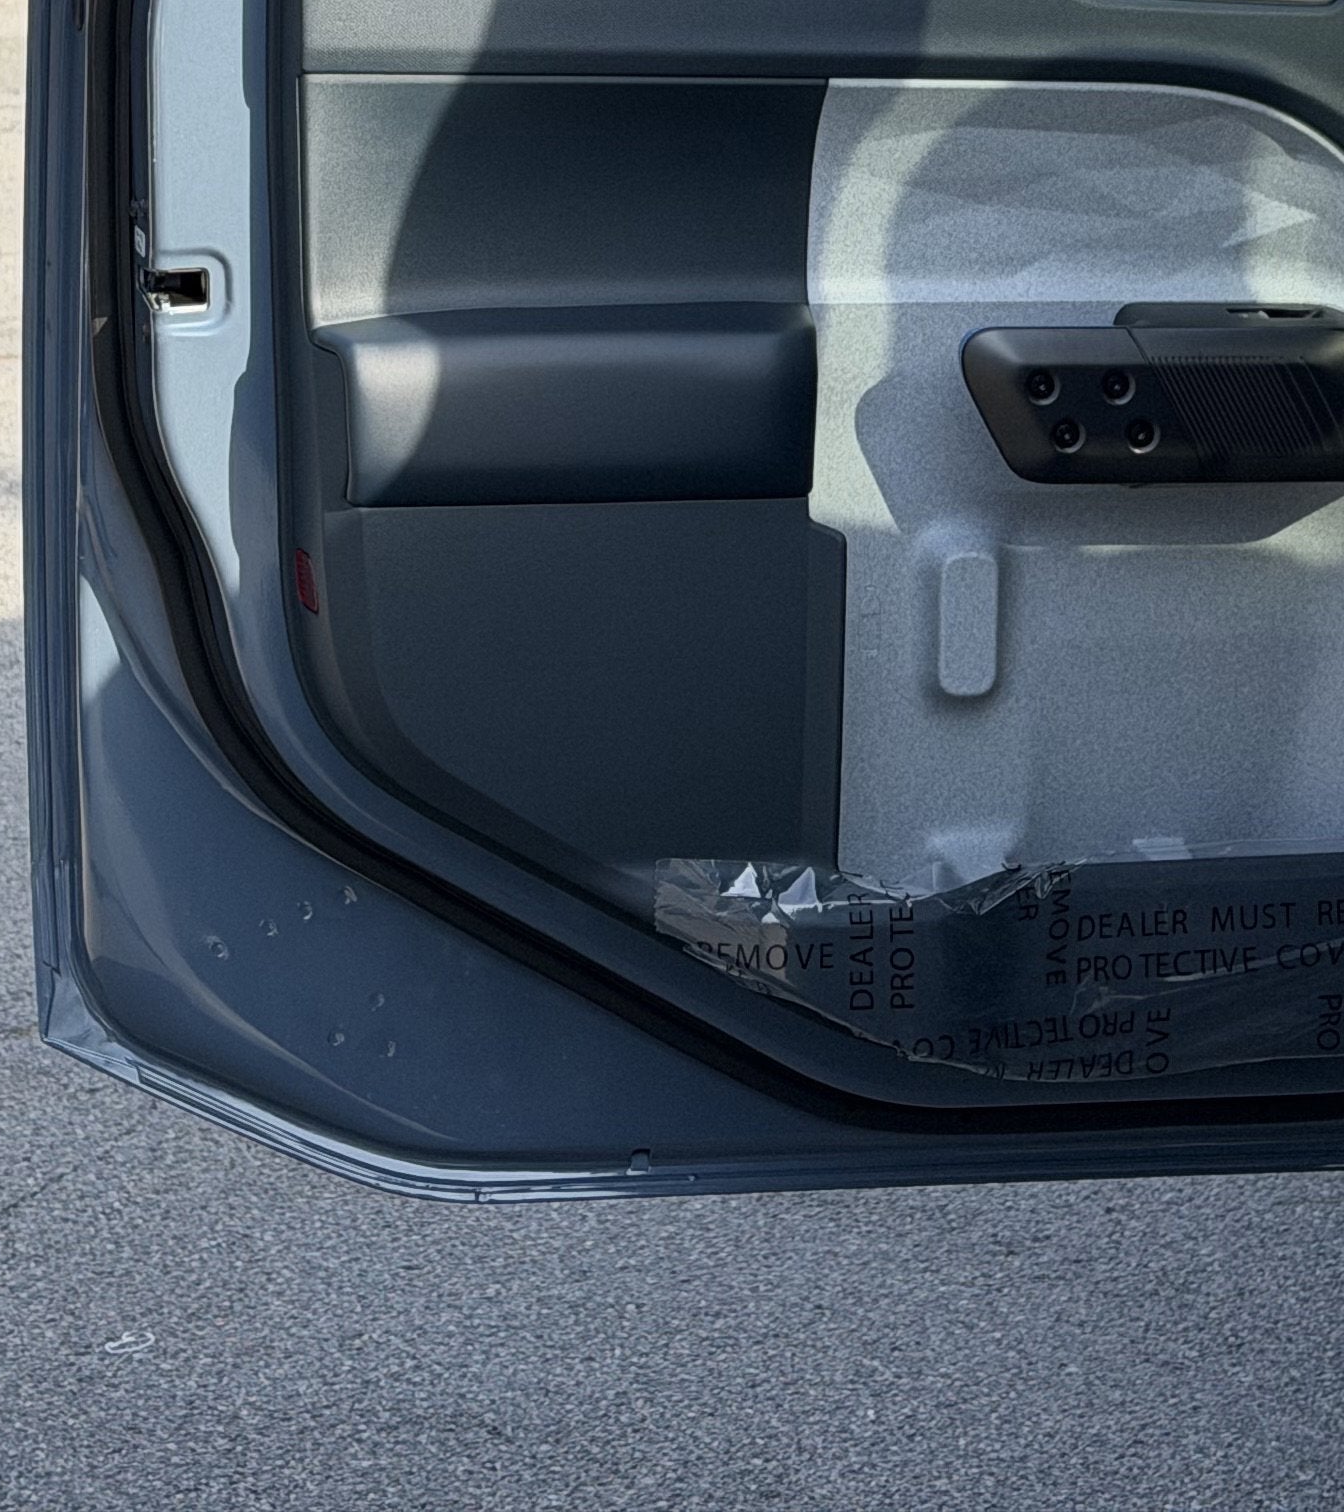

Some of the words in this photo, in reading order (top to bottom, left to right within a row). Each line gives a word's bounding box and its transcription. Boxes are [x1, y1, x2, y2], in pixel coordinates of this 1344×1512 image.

[1076, 909, 1189, 941] DEALER
[1210, 901, 1298, 933] MUST
[848, 892, 875, 1011] DEALER
[1075, 945, 1260, 986] PROTECTIVE
[968, 1010, 1137, 1051] PROTECTIVE
[1316, 993, 1343, 1050] PRO
